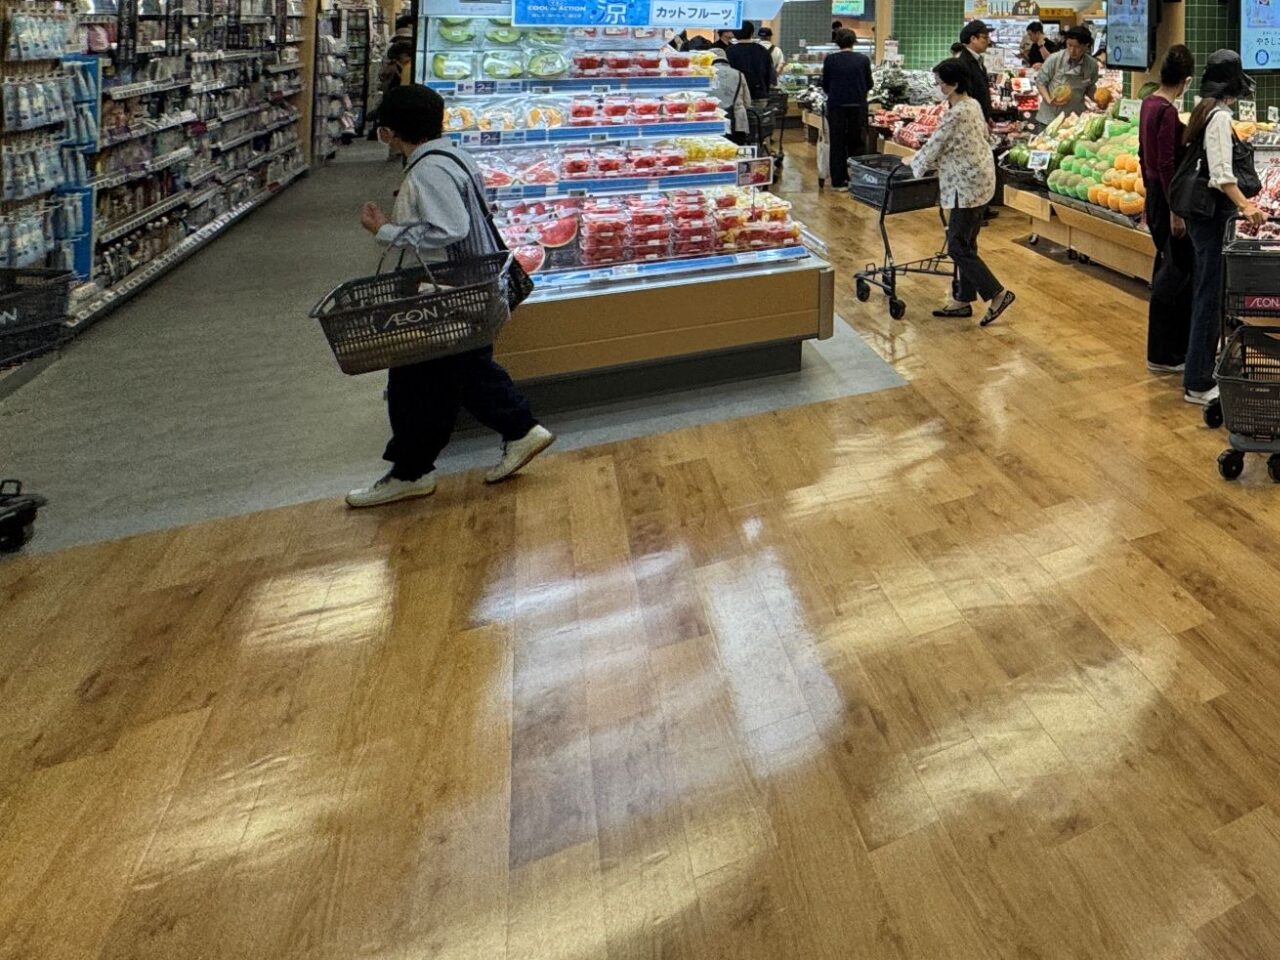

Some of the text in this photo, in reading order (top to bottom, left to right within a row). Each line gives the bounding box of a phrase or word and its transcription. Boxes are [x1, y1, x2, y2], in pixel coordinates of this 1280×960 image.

[656, 6, 732, 19] カットフルーツ
